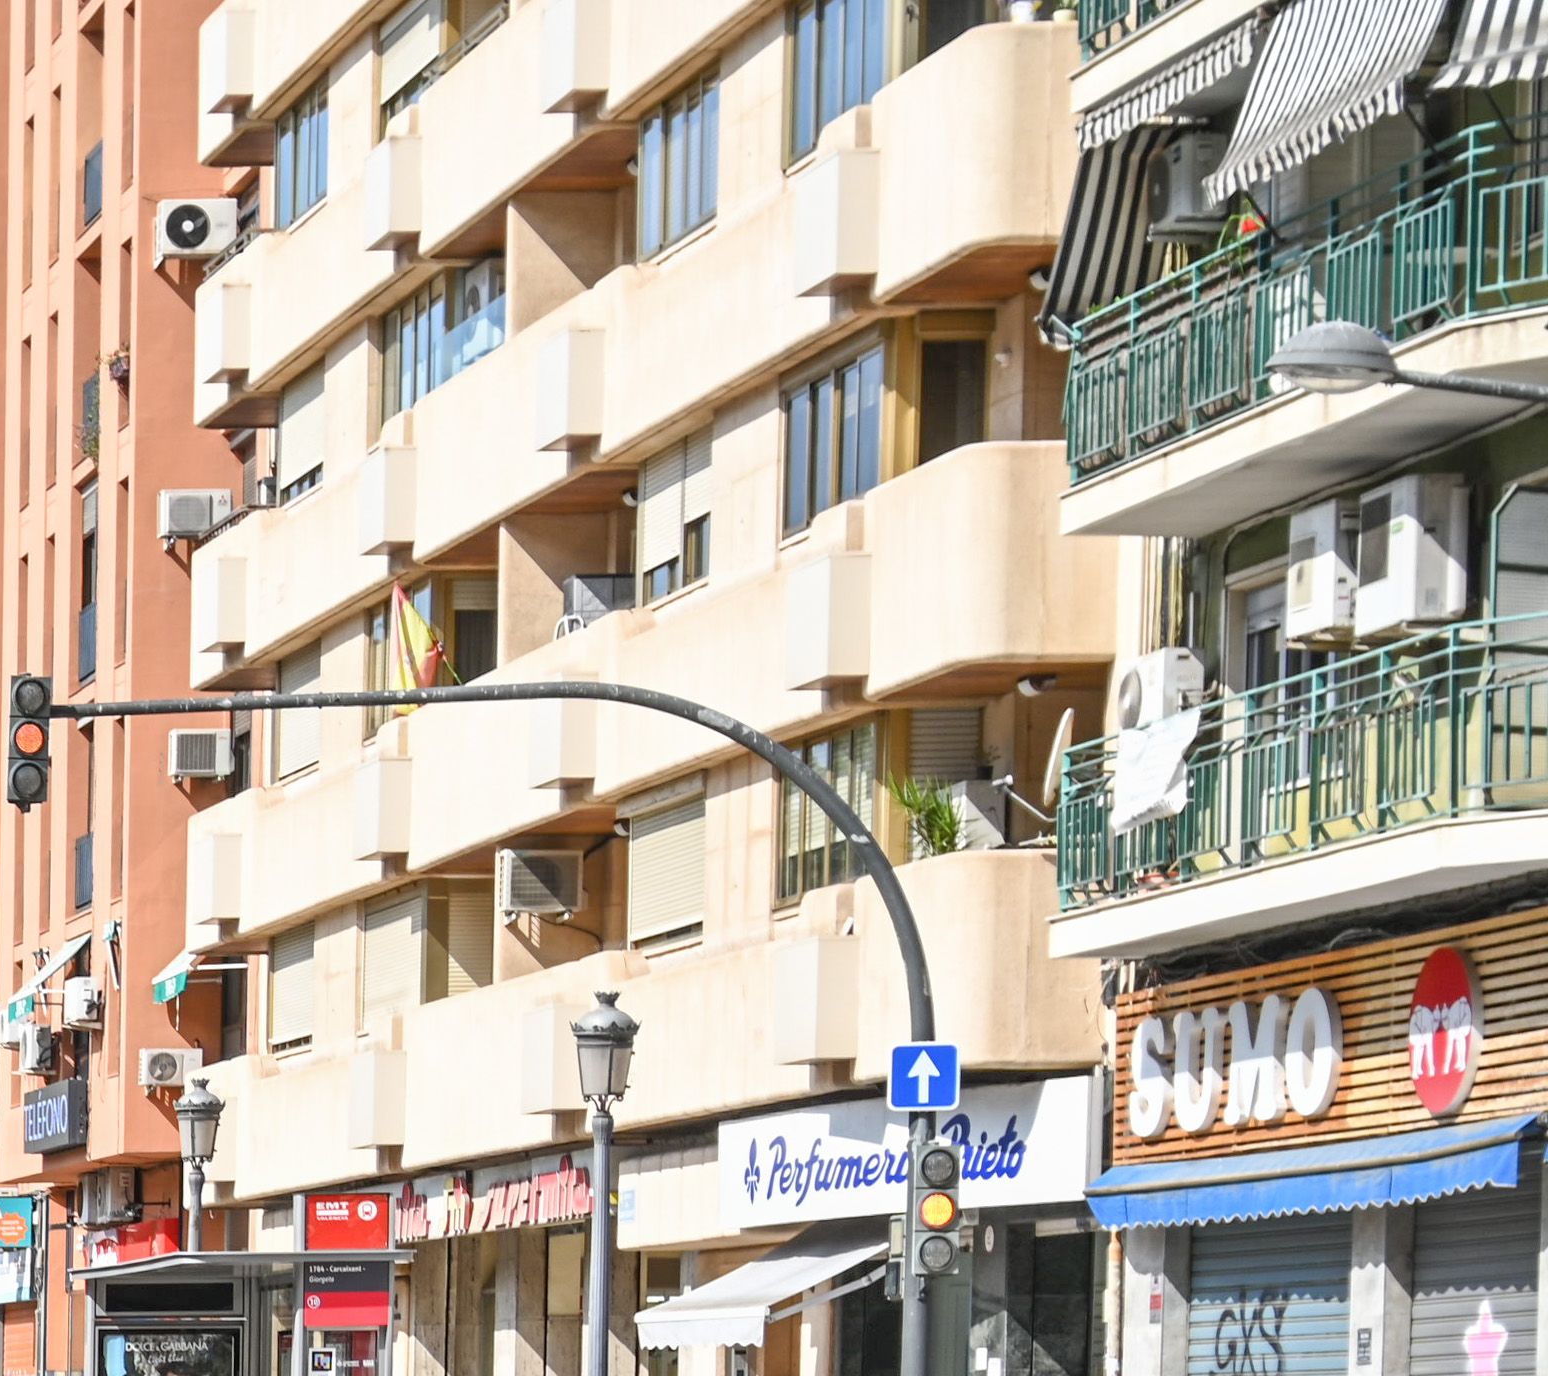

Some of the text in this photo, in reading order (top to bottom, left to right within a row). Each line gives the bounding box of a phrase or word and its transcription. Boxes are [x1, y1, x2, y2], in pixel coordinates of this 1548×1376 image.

[1130, 988, 1340, 1137] SUMO
[24, 1090, 68, 1142] TELÉFONO
[316, 1201, 349, 1210] EMT
[125, 1341, 156, 1352] DOLCE
[160, 1341, 209, 1352] GABBANA
